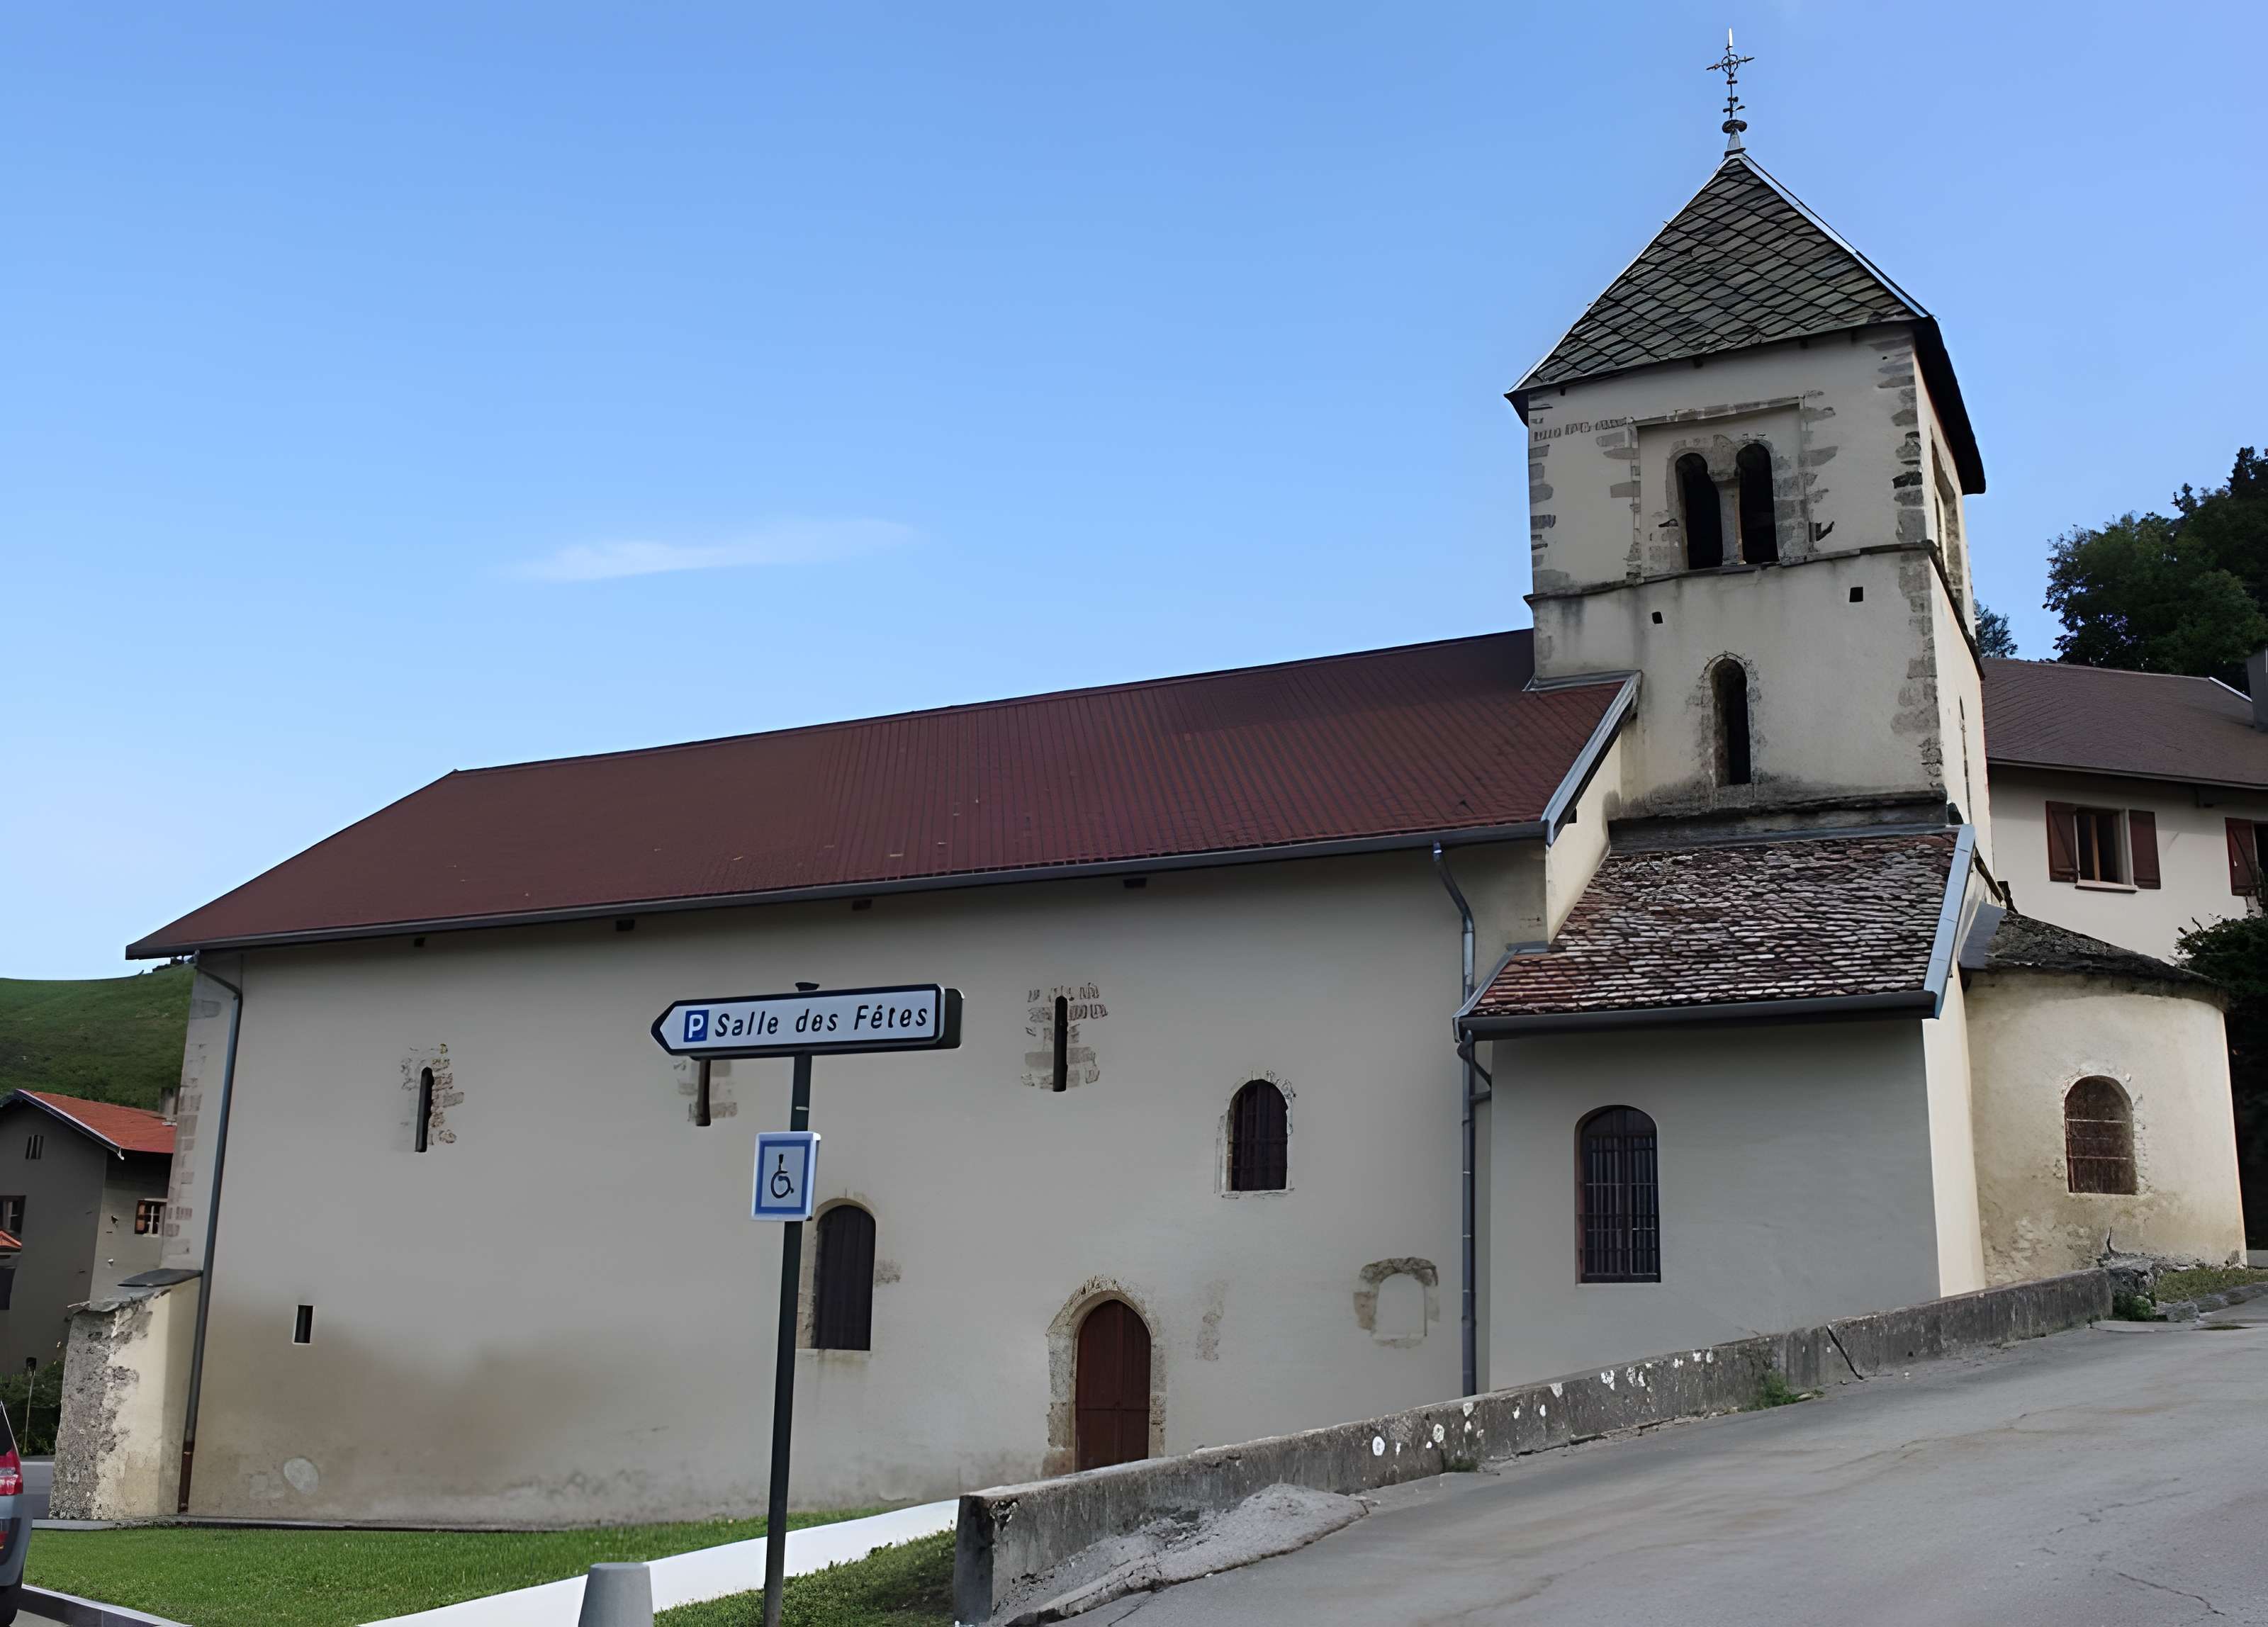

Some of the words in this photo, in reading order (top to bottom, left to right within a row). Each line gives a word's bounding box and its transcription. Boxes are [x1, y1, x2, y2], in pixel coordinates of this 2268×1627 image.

[687, 1013, 704, 1039] P
[714, 1010, 779, 1037] Salle
[795, 1008, 838, 1033] des
